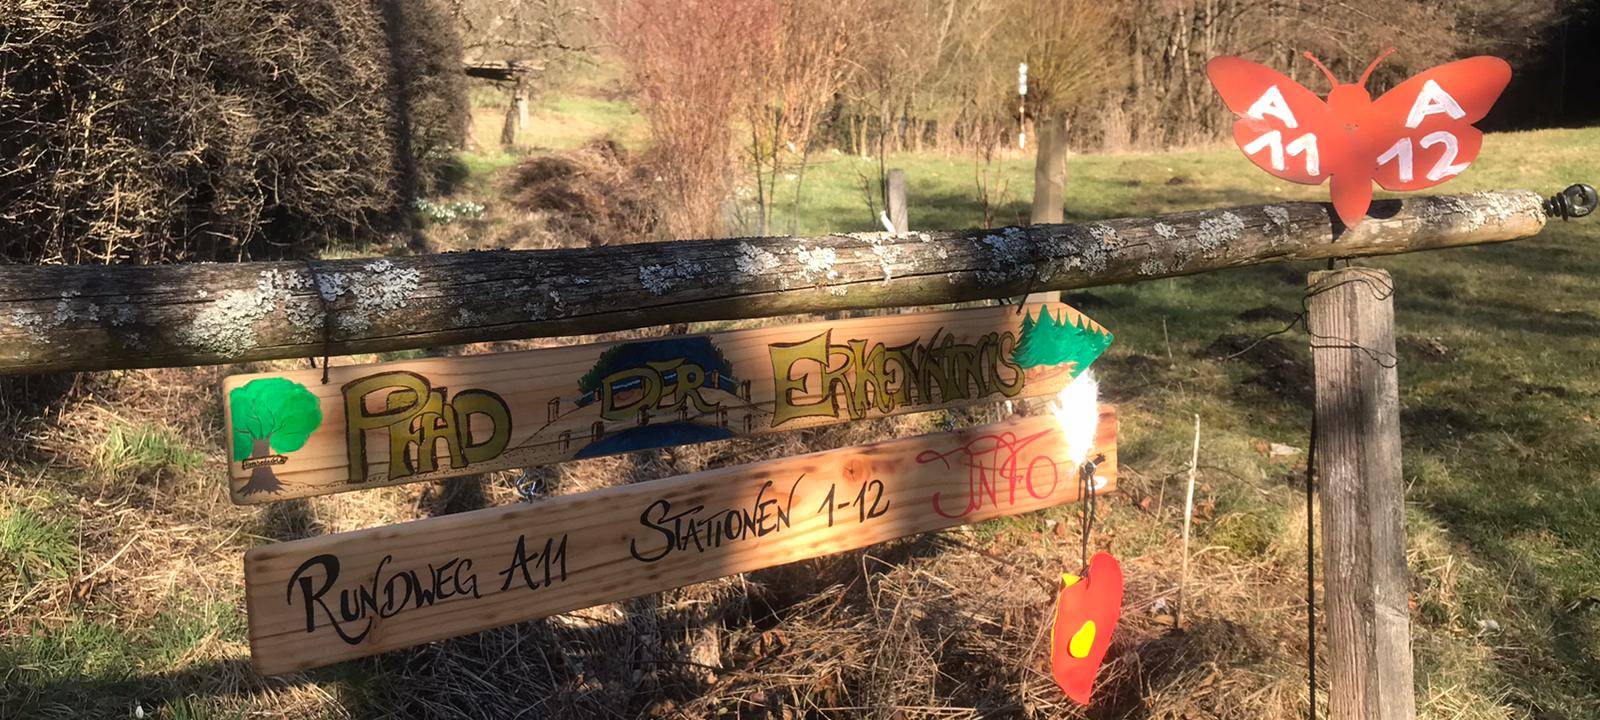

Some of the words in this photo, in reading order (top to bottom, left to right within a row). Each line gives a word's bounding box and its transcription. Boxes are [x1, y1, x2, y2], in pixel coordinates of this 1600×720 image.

[1246, 84, 1298, 129] A
[1404, 79, 1467, 128] A
[1243, 129, 1320, 176] 11
[1376, 130, 1471, 183] 12
[341, 370, 512, 485] PFAD
[600, 357, 719, 421] DER
[499, 534, 569, 591] A11
[816, 478, 891, 528] 1-12
